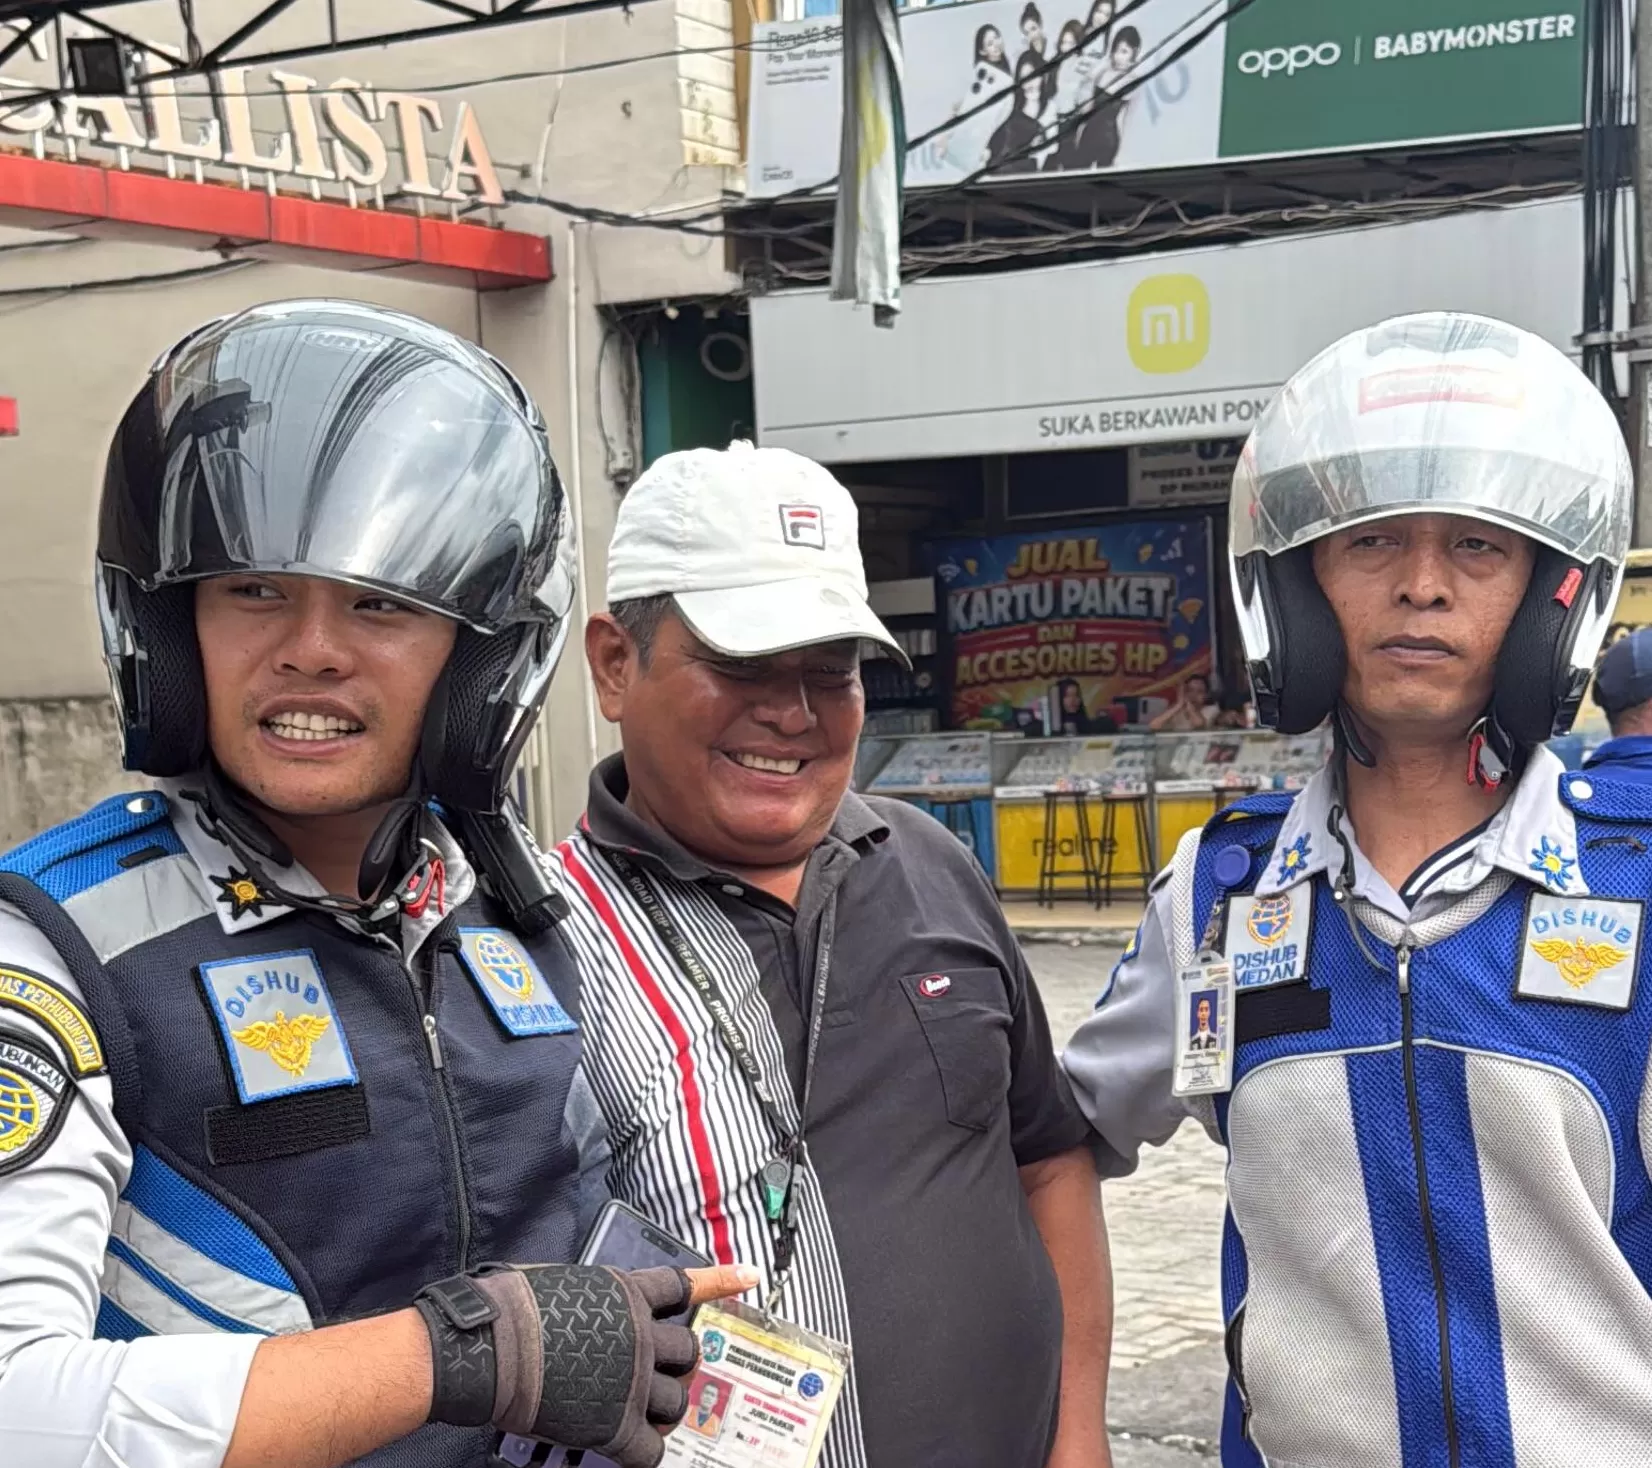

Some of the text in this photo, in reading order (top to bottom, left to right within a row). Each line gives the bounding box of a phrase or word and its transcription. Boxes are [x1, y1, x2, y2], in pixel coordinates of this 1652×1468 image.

[1238, 14, 1576, 78] oppo BABYMONSTER
[1039, 412, 1095, 438] SUKA
[1099, 403, 1217, 433] BERKAWAN
[1007, 538, 1109, 578] JUAL
[951, 575, 1173, 631] KARTU PAKET
[1037, 623, 1077, 643] DAN
[956, 642, 1168, 685] ACCESORIES HP
[1532, 908, 1632, 944] DISHUB
[630, 876, 758, 1075] ROAD TRIP DREAMER PROMISE YOU
[1234, 943, 1298, 970] DISHUB
[1235, 961, 1296, 987] MEDAN
[225, 970, 320, 1018] DISHUB
[22, 981, 99, 1065] PERHUBUNGAN
